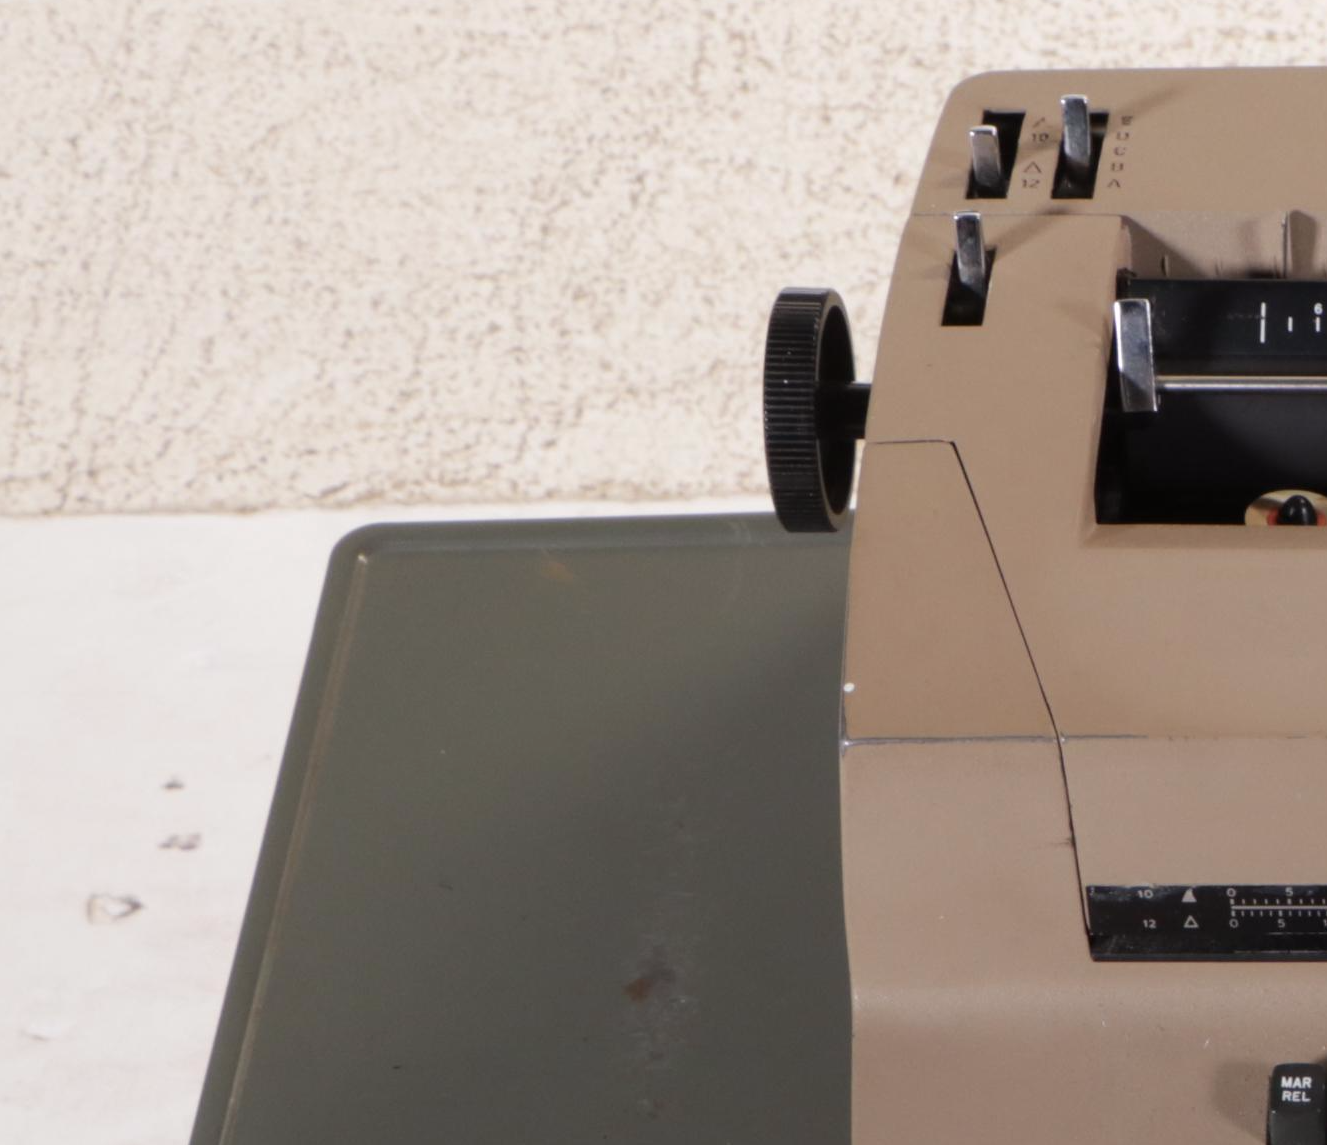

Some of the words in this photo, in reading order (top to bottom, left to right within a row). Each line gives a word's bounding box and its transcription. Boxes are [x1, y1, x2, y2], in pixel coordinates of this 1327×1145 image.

[1022, 179, 1040, 189] 12
[1313, 302, 1323, 314] 6
[1138, 888, 1155, 898] 10
[1227, 888, 1236, 897] 0
[1285, 887, 1294, 896] 5
[1143, 919, 1156, 928] 12
[1229, 919, 1238, 928] 0
[1277, 919, 1286, 927] 5
[1281, 1077, 1311, 1088] MAR
[1282, 1091, 1310, 1102] REL
